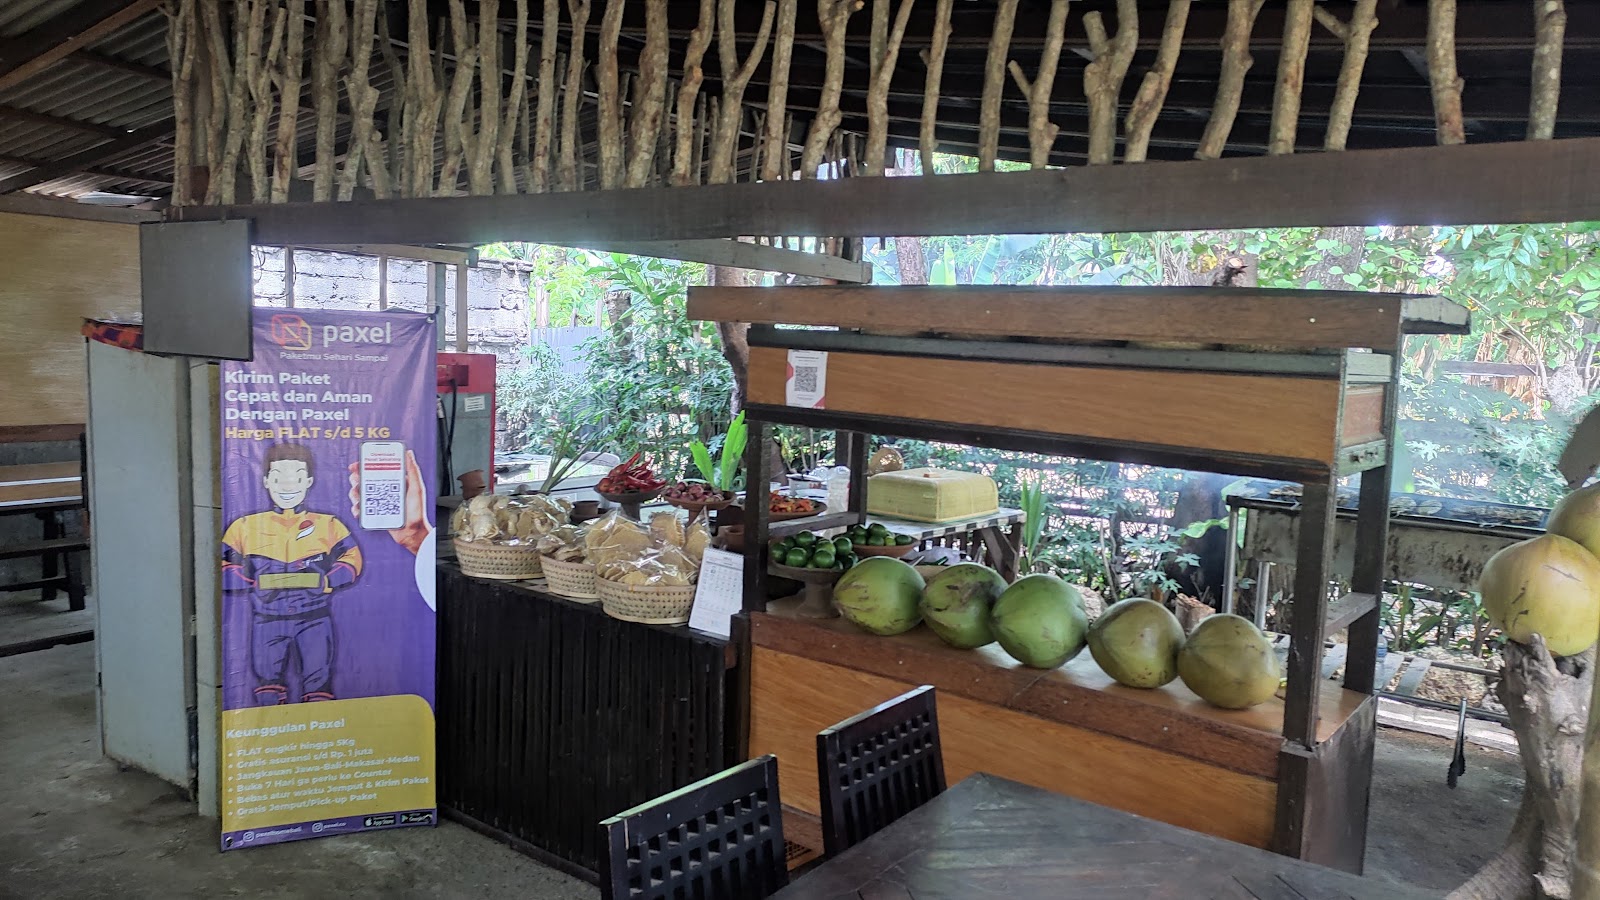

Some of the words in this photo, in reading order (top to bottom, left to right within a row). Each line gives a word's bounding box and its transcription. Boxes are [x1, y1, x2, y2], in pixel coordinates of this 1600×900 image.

[322, 322, 391, 348] paxel
[279, 351, 321, 361] Paketmu
[323, 352, 353, 361] Sehari
[354, 353, 388, 363] Sampai
[224, 370, 274, 384] Kirim
[279, 372, 331, 385] Paket
[224, 390, 279, 404] Cepat
[283, 390, 317, 403] dan
[321, 391, 373, 403] Aman
[225, 408, 297, 423] Dengan
[302, 408, 349, 421] Paxel
[225, 427, 275, 441] Harga
[278, 427, 321, 439] FLAT
[324, 426, 350, 440] s/d
[354, 427, 365, 438] 5
[368, 427, 391, 439] KG
[226, 723, 307, 739] Keunggulan
[309, 719, 345, 730] Paxel
[237, 747, 262, 757] FLAT
[300, 741, 334, 750] hingga
[237, 758, 267, 769] Gratis
[354, 747, 374, 757] juta
[237, 782, 263, 793] Buka
[265, 780, 272, 788] 7
[274, 779, 295, 788] Hari
[311, 774, 338, 784] perlu
[340, 772, 351, 780] ke
[353, 769, 392, 779] Counter
[327, 782, 364, 793] Jemput
[374, 779, 400, 788] Kirim
[402, 776, 429, 785] Paket
[237, 804, 267, 816] Gratis
